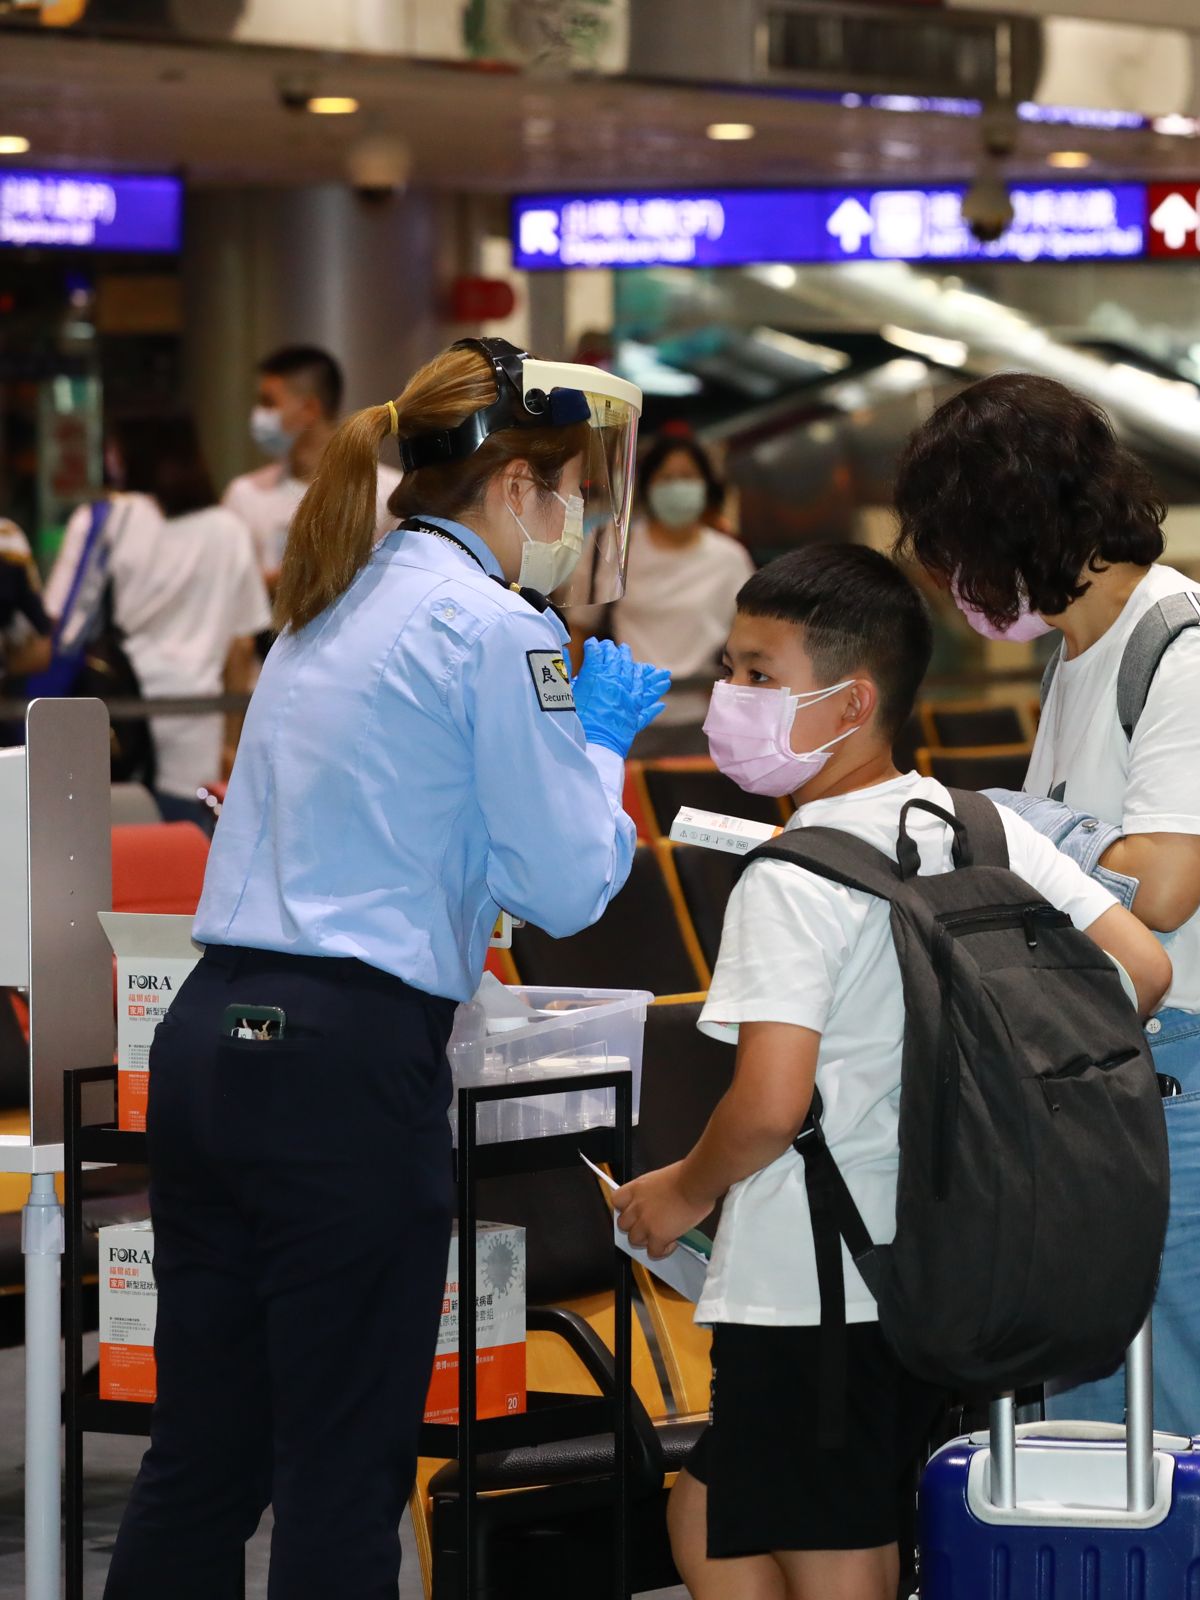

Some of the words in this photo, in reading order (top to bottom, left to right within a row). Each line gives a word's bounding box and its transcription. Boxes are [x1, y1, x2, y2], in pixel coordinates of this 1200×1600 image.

[541, 665, 557, 685] 良
[128, 974, 172, 990] FORA
[109, 1247, 152, 1265] FORA
[126, 1279, 158, 1290] 新型冠狀
[507, 1397, 518, 1410] 20
